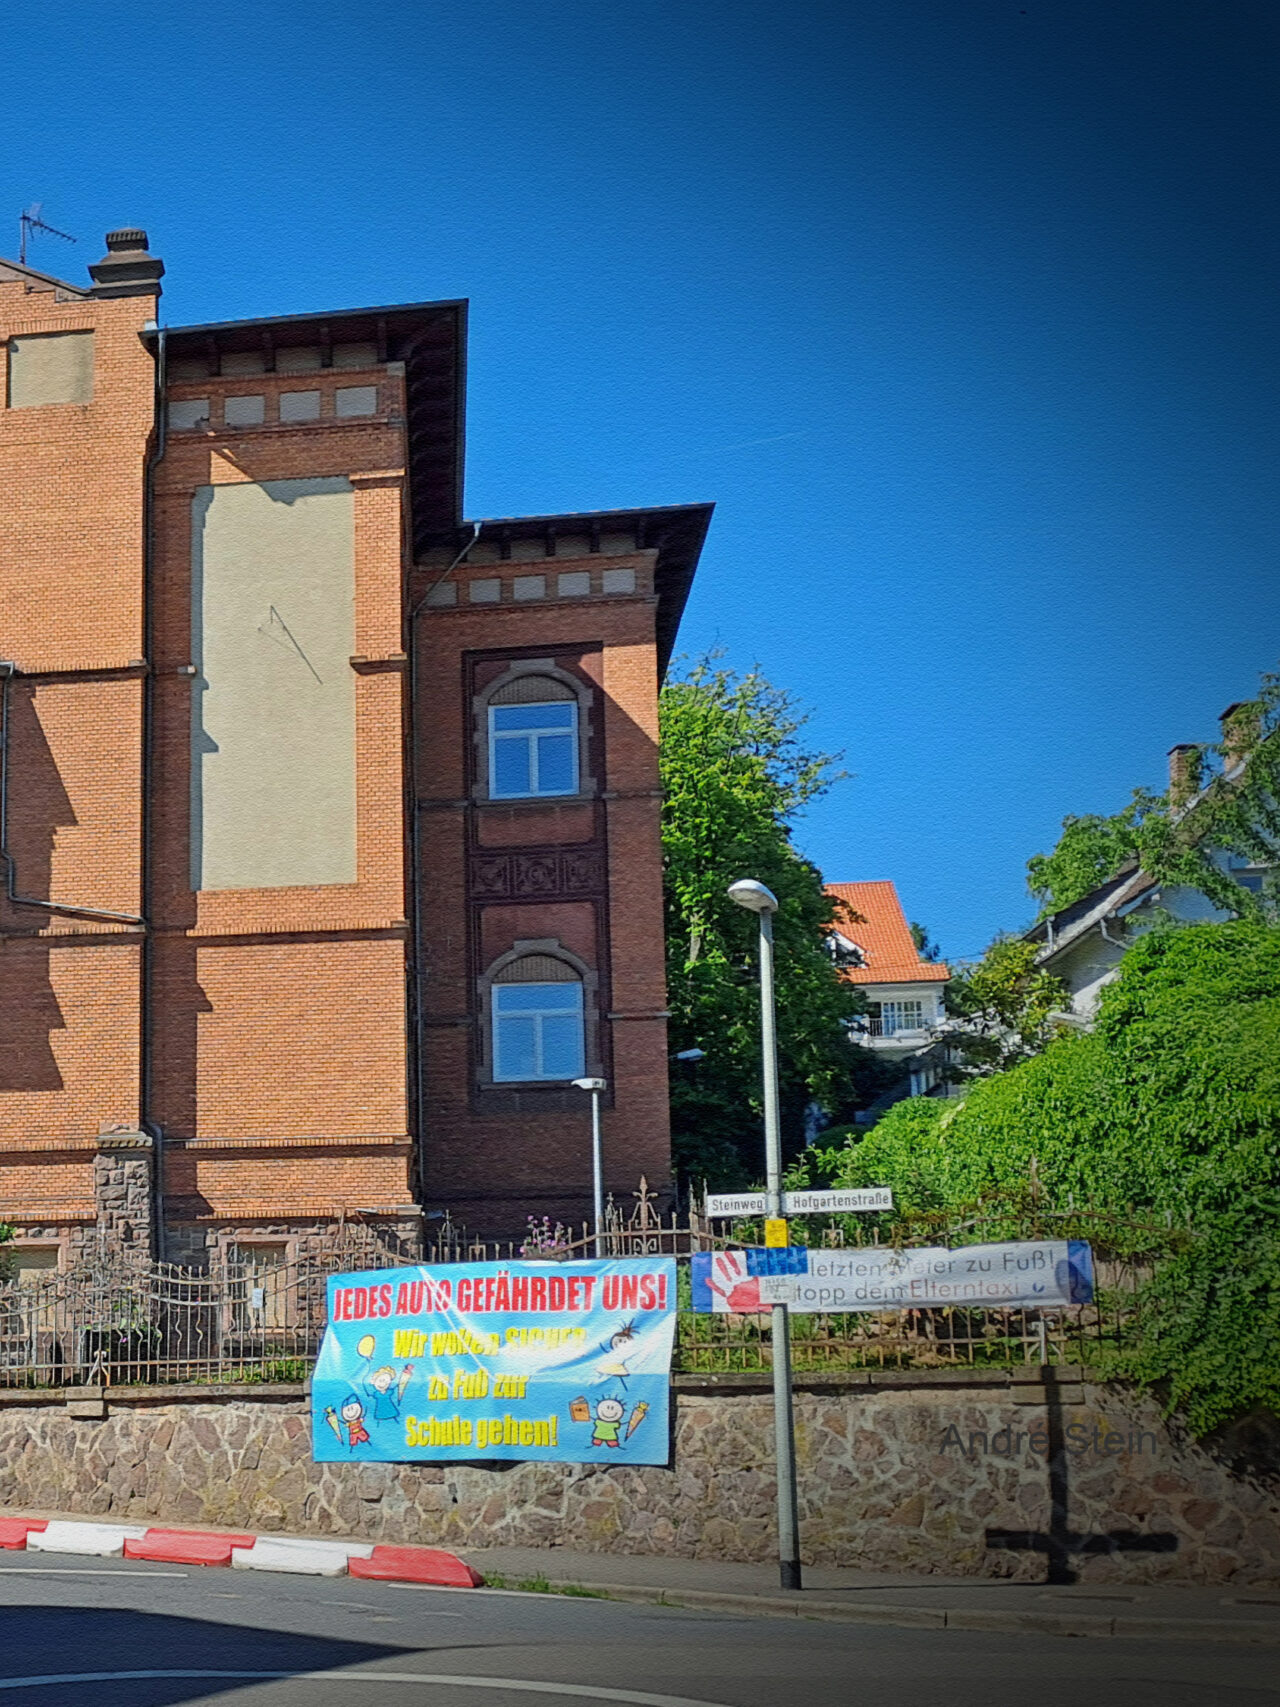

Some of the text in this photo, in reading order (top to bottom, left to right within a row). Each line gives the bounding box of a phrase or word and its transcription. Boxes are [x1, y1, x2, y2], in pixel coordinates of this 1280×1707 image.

[712, 1198, 763, 1213] Steinweg
[793, 1191, 889, 1210] Hofgartenstraße
[966, 1259, 991, 1273] zu
[1002, 1249, 1054, 1271] Fuß!
[333, 1271, 668, 1321] JEDES AUTO GEFÄHRDET UNS!
[796, 1285, 846, 1305] topp
[855, 1280, 904, 1300] dem
[910, 1278, 1020, 1298] Elterntaxi
[393, 1329, 429, 1359] Wir
[427, 1374, 450, 1401] zu
[493, 1373, 530, 1399] zur
[405, 1414, 558, 1449] Schule gehen!
